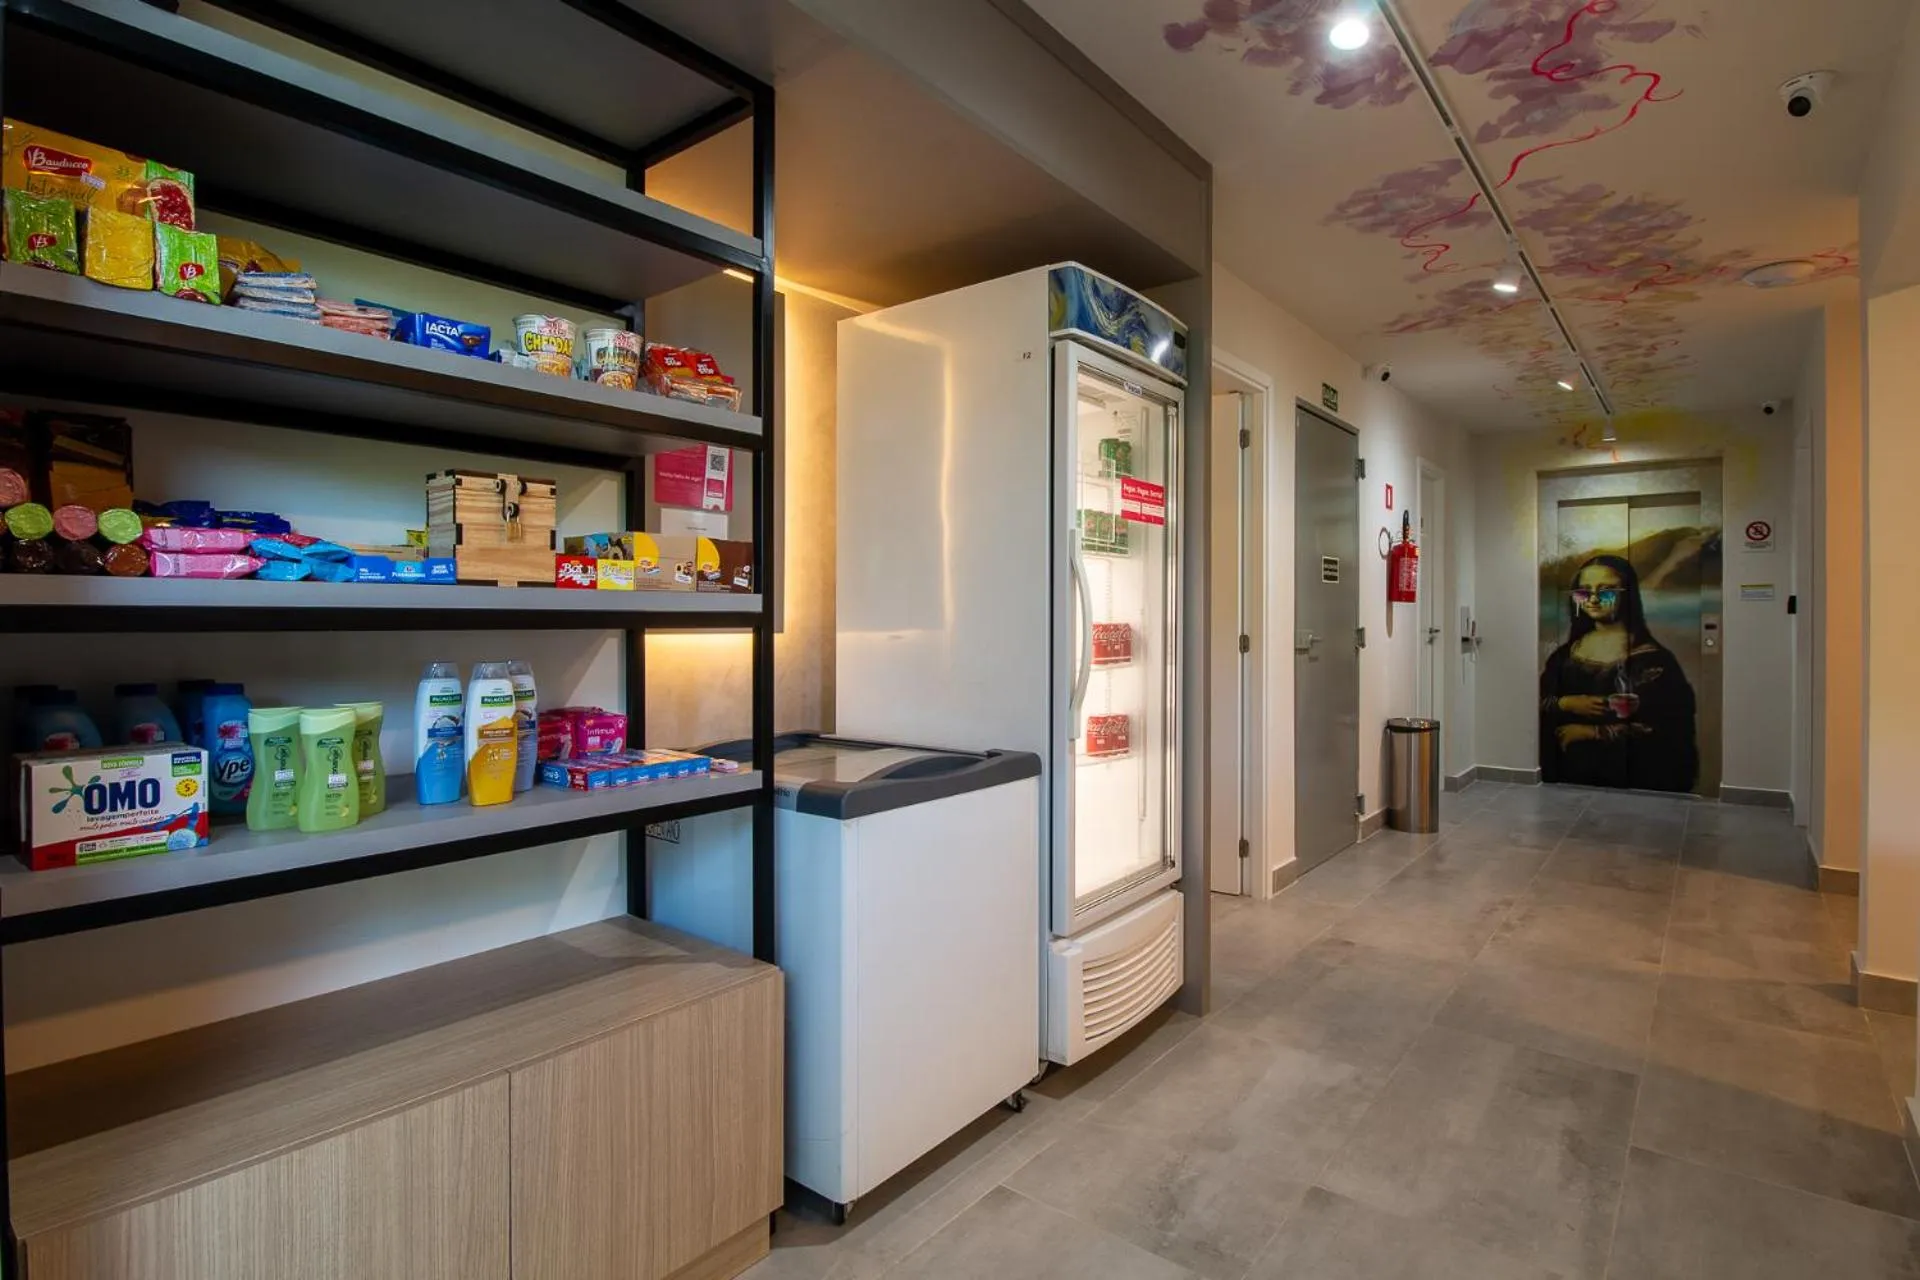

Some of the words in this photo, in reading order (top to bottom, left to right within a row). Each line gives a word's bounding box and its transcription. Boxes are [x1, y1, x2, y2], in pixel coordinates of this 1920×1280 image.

[28, 148, 88, 169] Bauducco
[425, 321, 459, 336] LACTA
[84, 777, 161, 815] OMO
